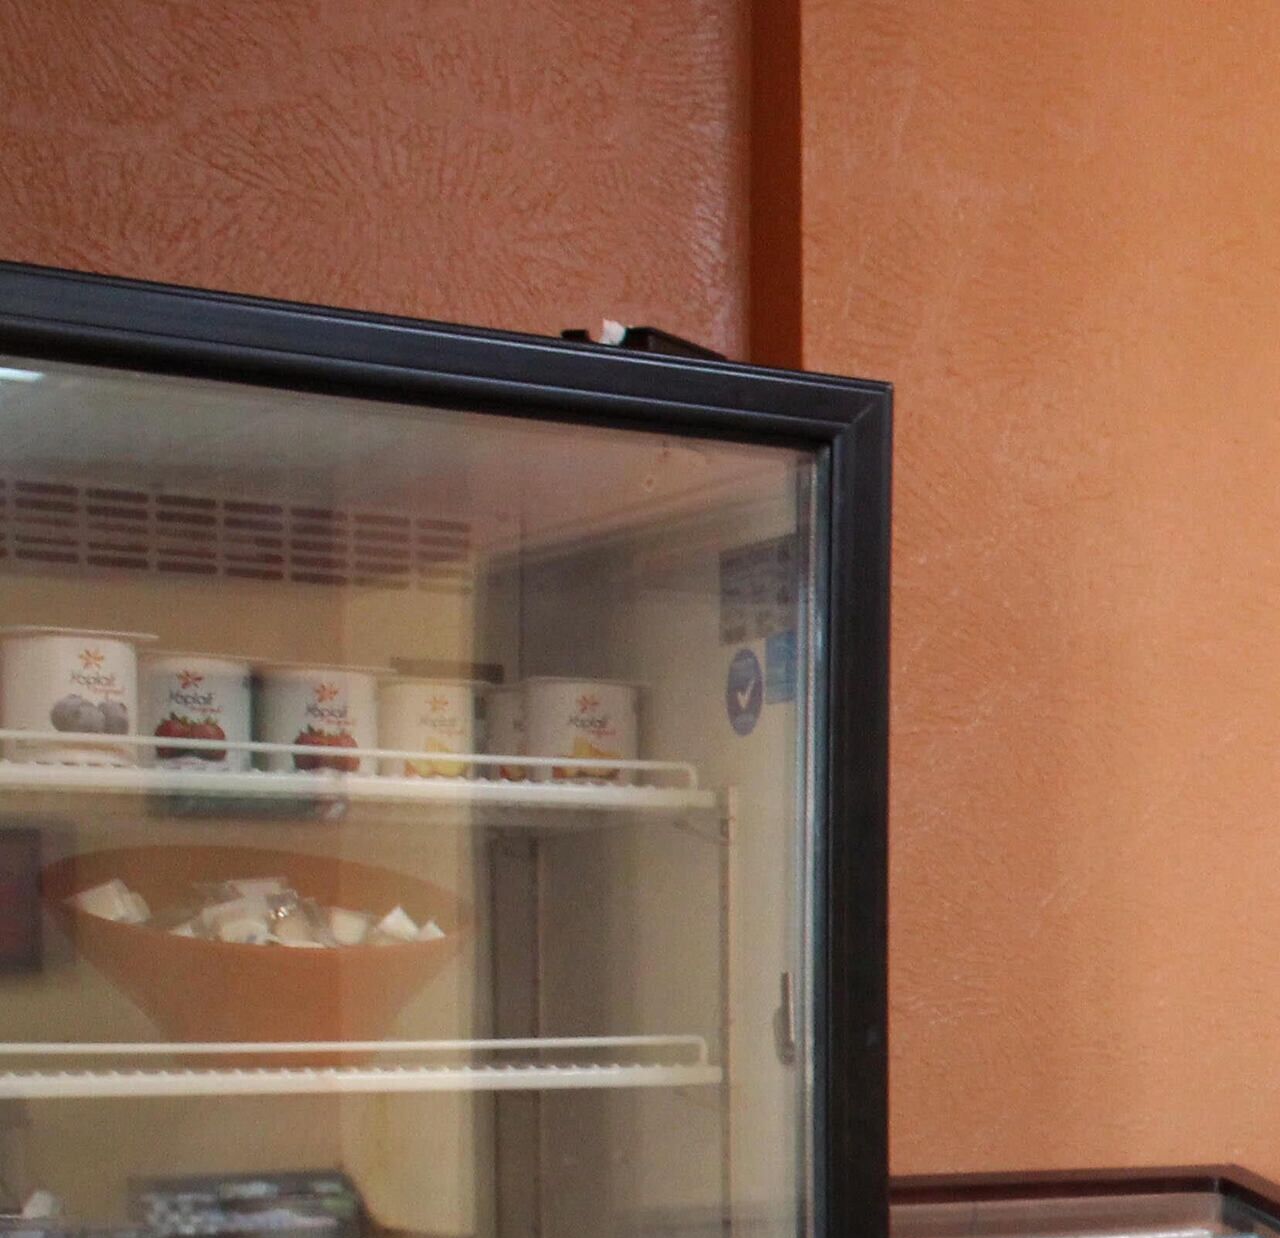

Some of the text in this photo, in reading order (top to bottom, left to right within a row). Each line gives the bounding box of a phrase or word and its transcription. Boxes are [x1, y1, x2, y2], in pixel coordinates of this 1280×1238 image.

[70, 671, 116, 687] Yoplait
[168, 689, 215, 706] Yoplait
[304, 704, 348, 720] Yoplait
